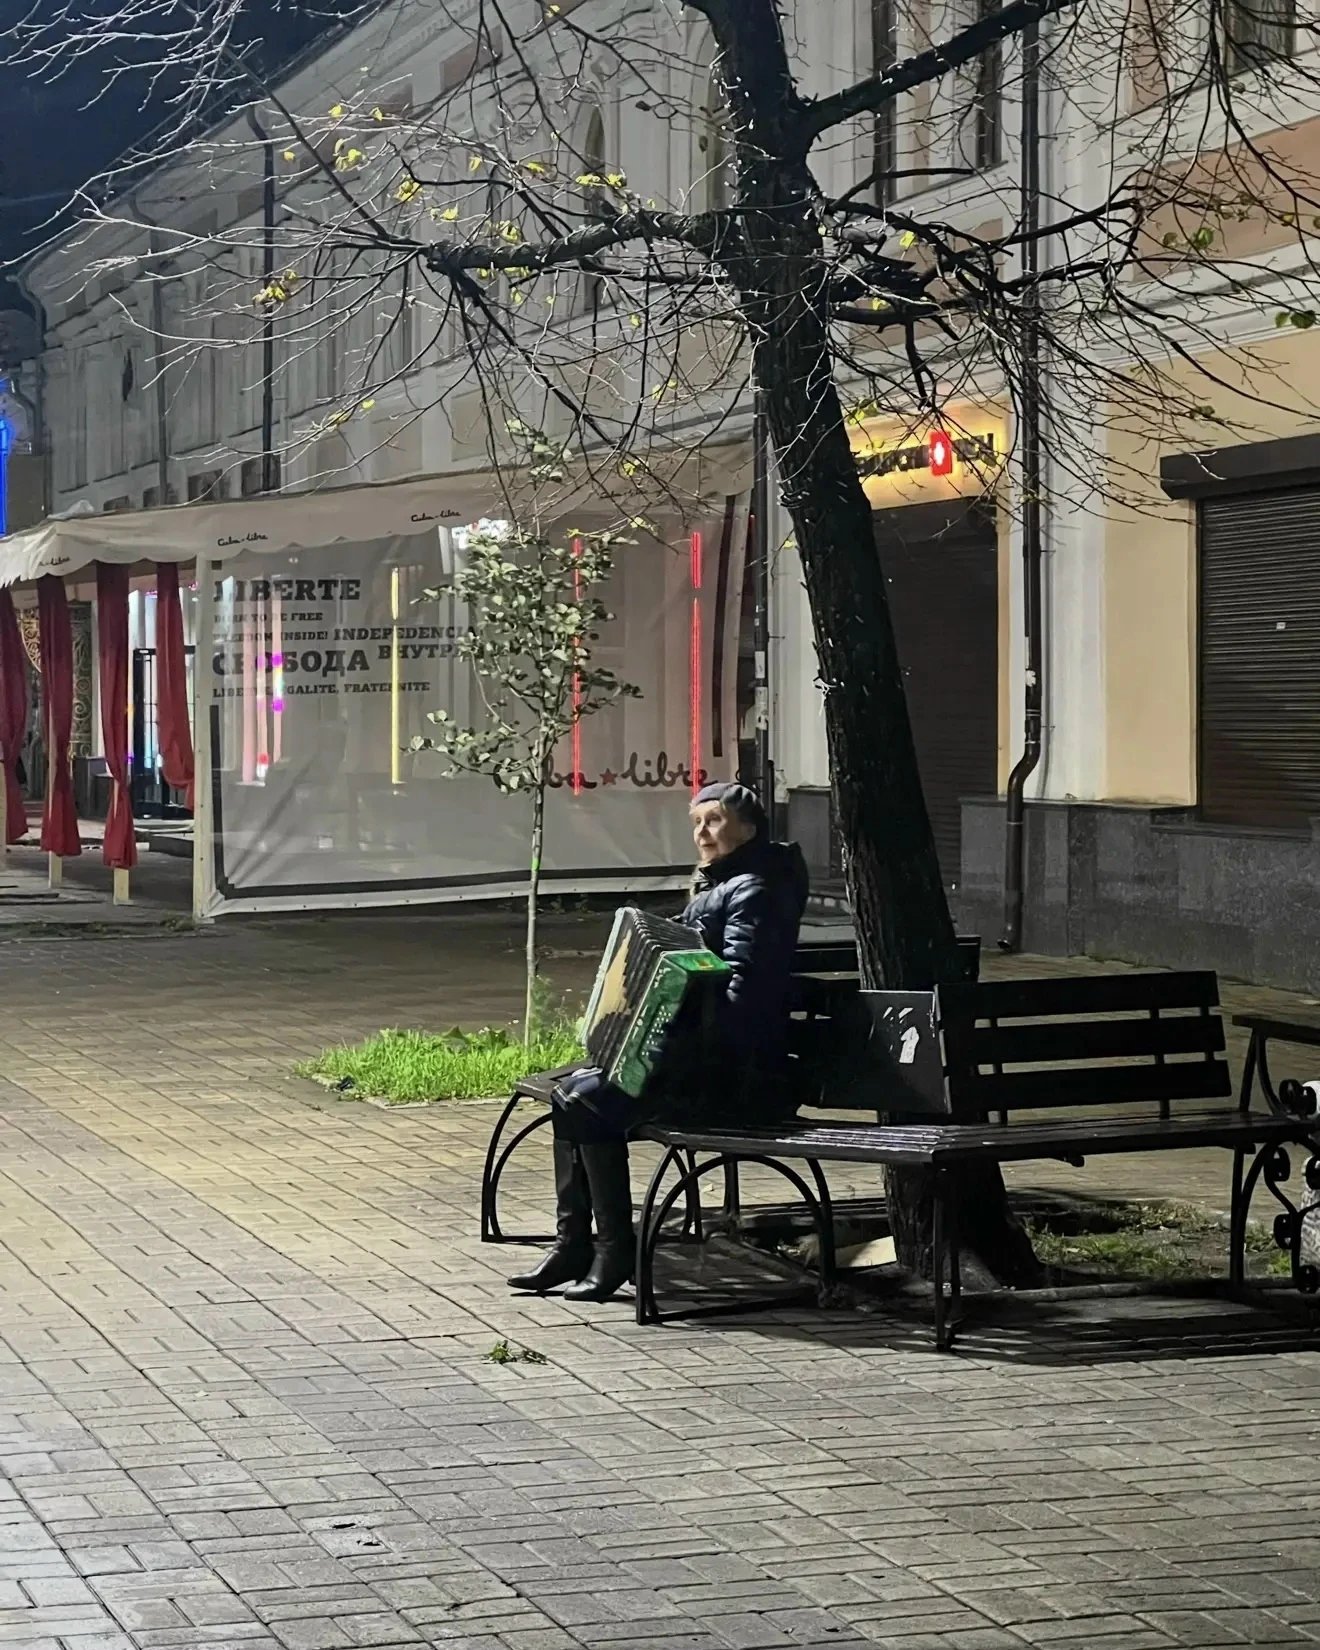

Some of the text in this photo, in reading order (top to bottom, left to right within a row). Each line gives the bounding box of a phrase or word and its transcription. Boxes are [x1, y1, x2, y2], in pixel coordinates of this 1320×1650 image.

[291, 612, 323, 621] FREE
[274, 631, 328, 641] NSIDE!
[275, 683, 339, 695] GALITE,
[621, 751, 718, 787] libre
